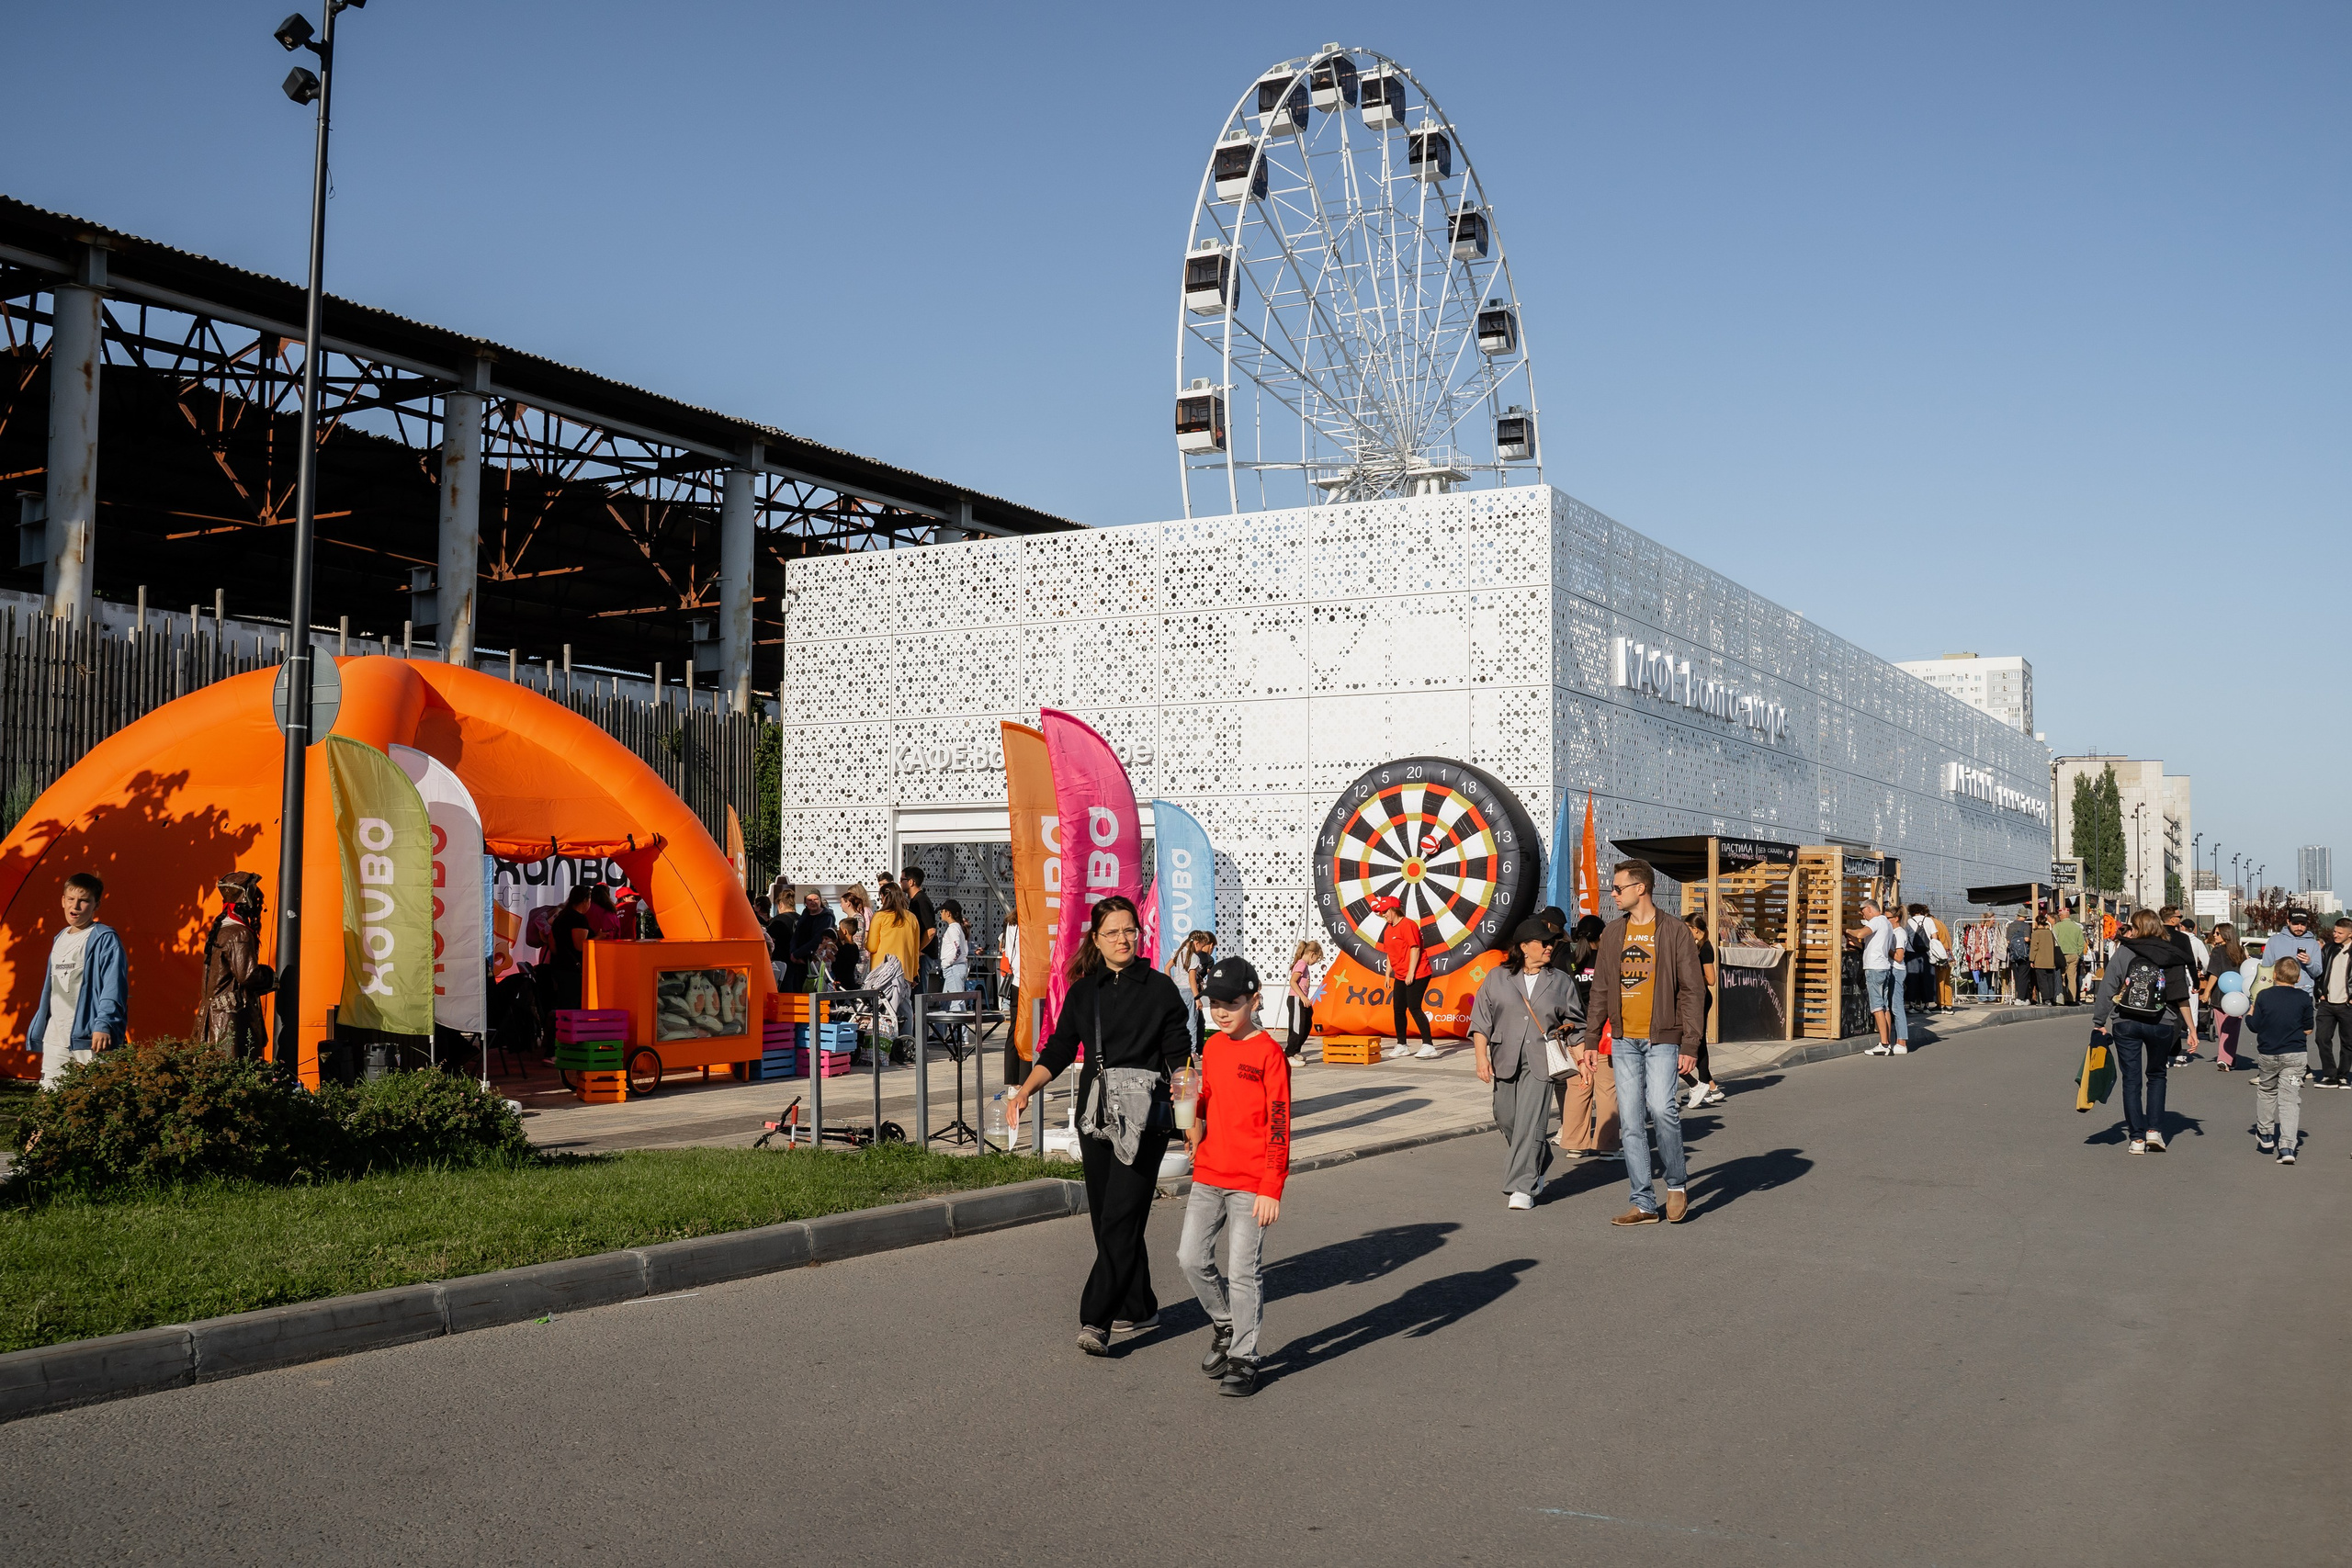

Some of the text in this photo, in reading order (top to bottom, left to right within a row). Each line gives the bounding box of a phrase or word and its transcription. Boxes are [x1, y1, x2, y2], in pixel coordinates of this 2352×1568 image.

[1617, 637, 1681, 704] КАФЕ
[892, 743, 968, 773] КАФЕ
[1381, 772, 1390, 784] 5
[1406, 766, 1422, 779] 20
[1441, 769, 1447, 781] 1
[1353, 784, 1369, 798] 12
[1461, 781, 1477, 794] 18
[1337, 807, 1345, 819] 9
[1485, 803, 1494, 816] 4
[1320, 835, 1335, 847] 14
[1495, 830, 1511, 843] 13
[1721, 842, 1753, 854] ПАСТИЛА
[1316, 864, 1329, 876] 11
[1502, 861, 1512, 874] 6
[1323, 894, 1331, 906] 8
[1494, 892, 1510, 905] 10
[1331, 921, 1347, 934] 16
[1479, 920, 1496, 933] 15
[1353, 943, 1362, 956] 7
[1463, 942, 1472, 955] 2
[1432, 958, 1449, 971] 17
